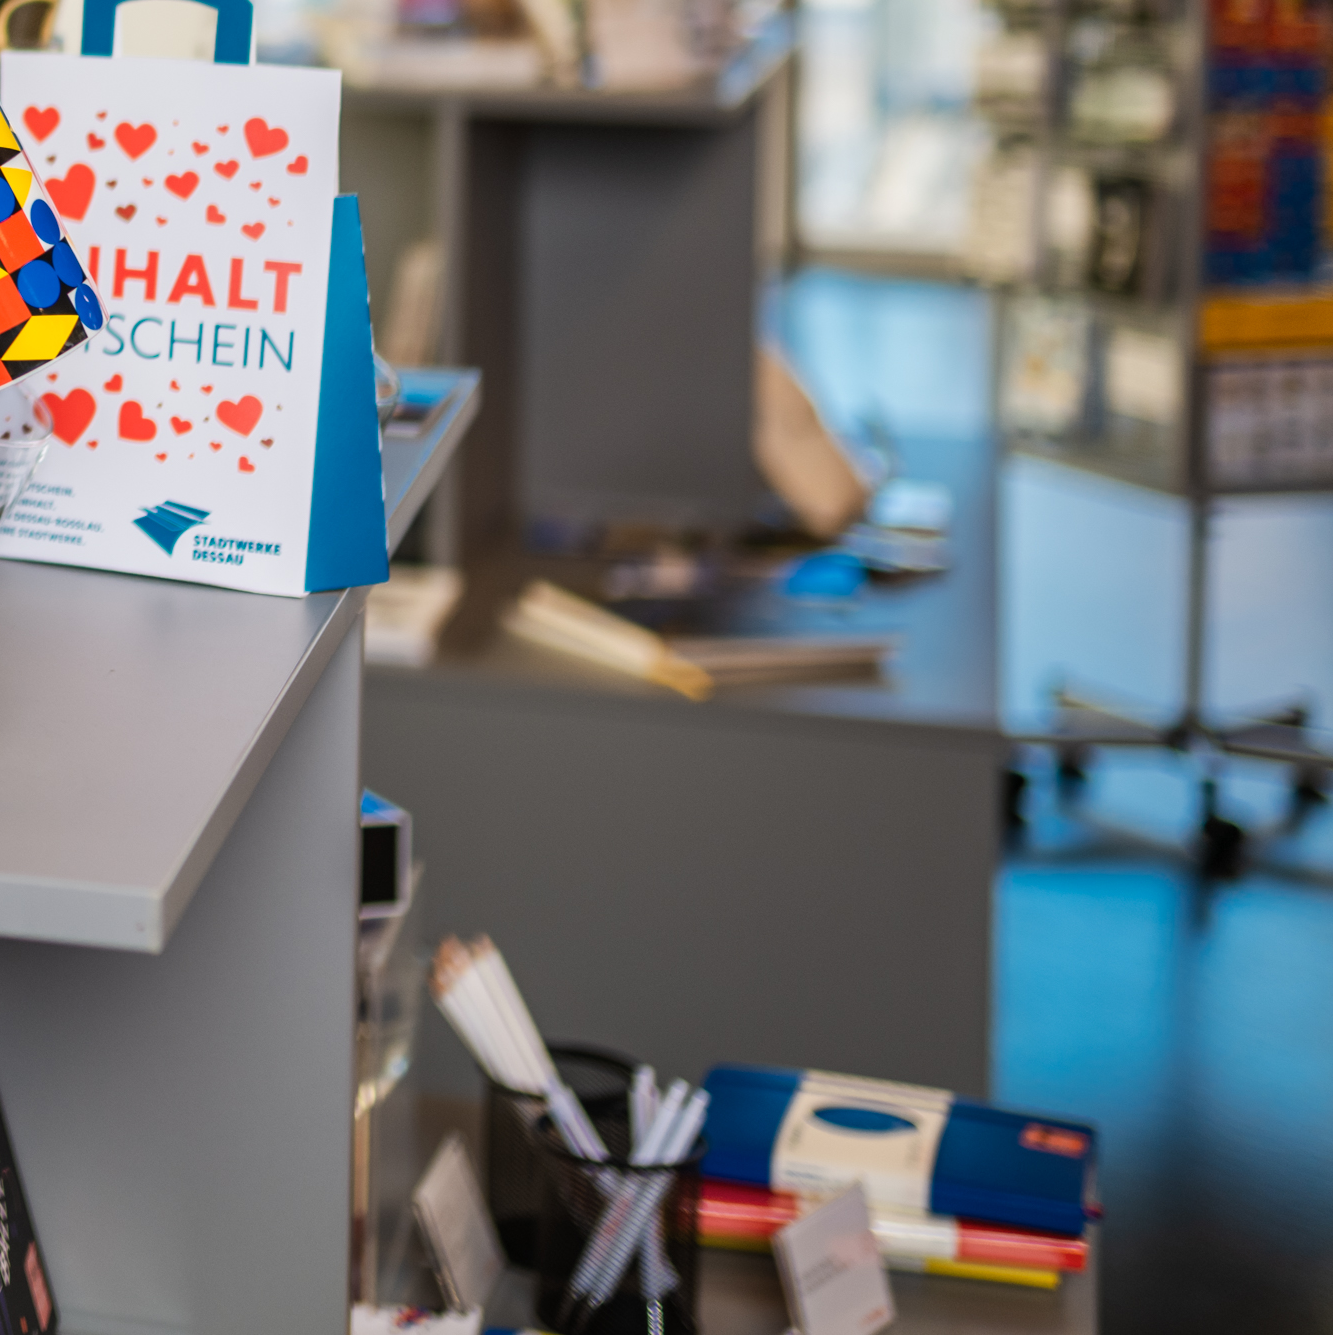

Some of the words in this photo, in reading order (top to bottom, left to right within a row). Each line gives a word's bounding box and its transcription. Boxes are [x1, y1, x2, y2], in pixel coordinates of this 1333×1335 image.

[88, 245, 303, 315] HALT
[84, 314, 295, 372] SCHEIN
[192, 549, 245, 566] DESSAU
[193, 534, 282, 556] STADTWERKE
